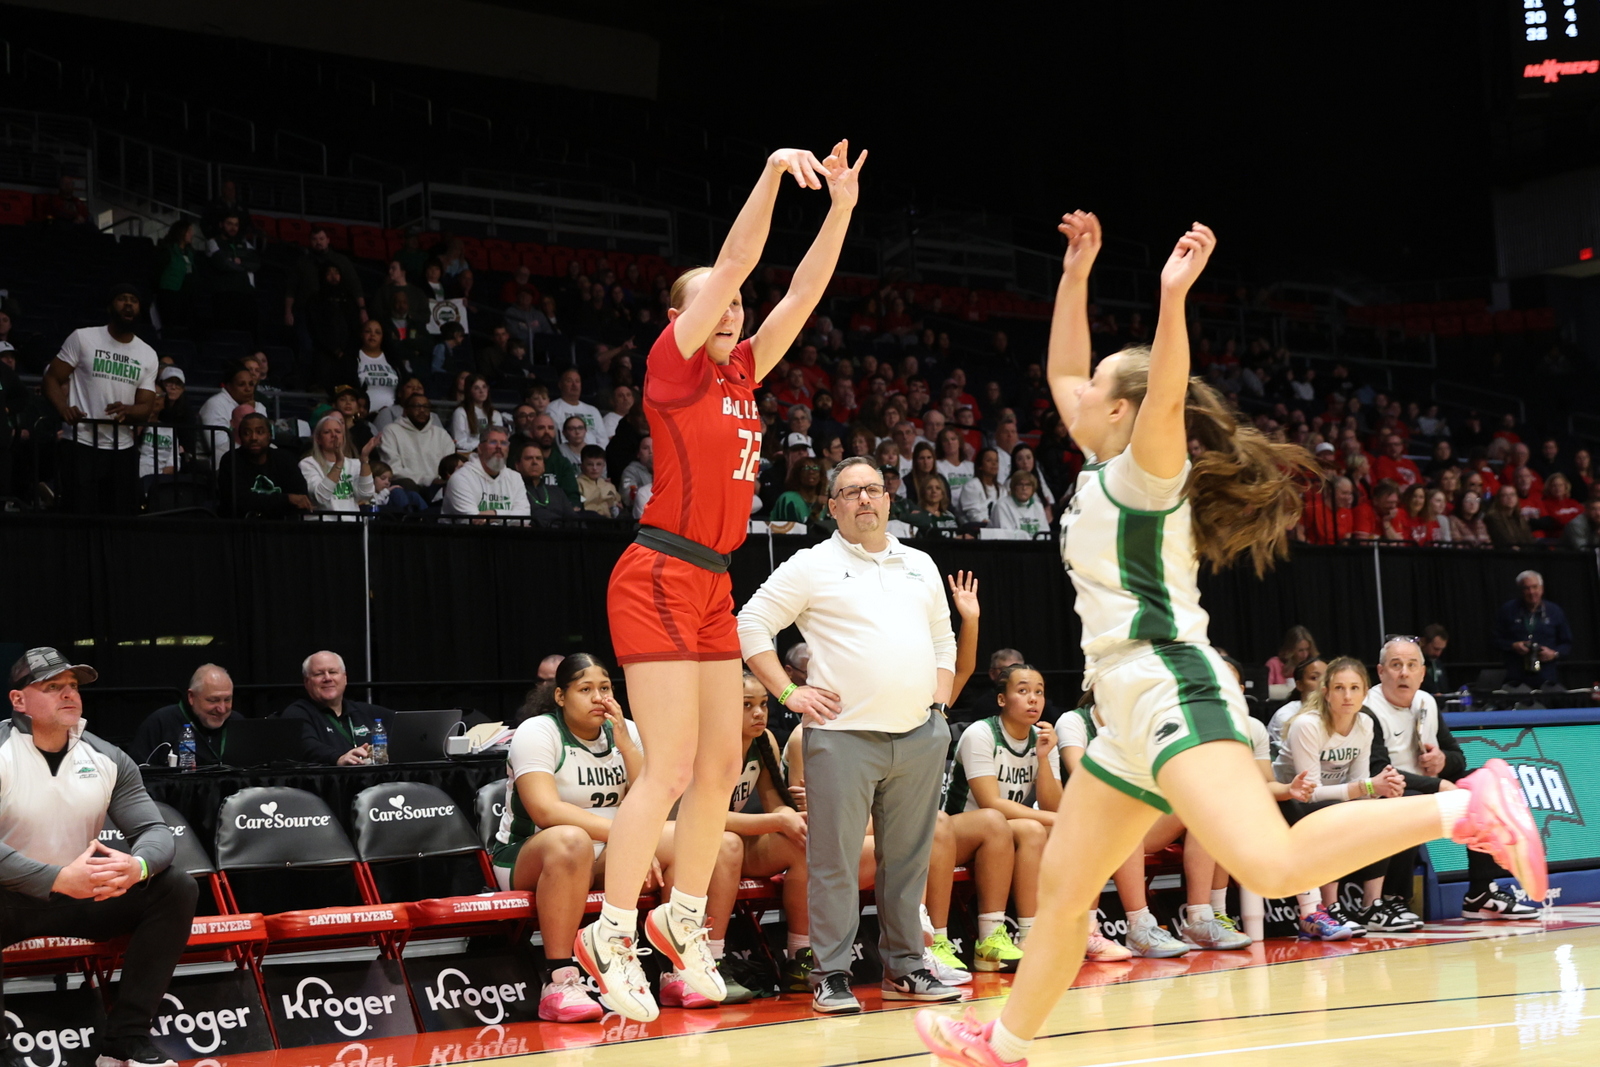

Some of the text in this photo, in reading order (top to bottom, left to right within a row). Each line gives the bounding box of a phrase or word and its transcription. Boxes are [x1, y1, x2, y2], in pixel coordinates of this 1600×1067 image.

[1525, 8, 1577, 25] 30 4
[1565, 23, 1578, 38] 4
[95, 349, 130, 364] IT'S OUR
[92, 358, 142, 382] MOMENT
[364, 376, 399, 388] ATORS
[732, 428, 762, 482] 32
[577, 764, 626, 787] LAUREL
[235, 813, 331, 830] CareSource
[369, 805, 454, 823] CareSource
[454, 898, 530, 913] DAYTON FLYERS
[308, 910, 394, 926] DAYTON FLYERS
[208, 920, 252, 934] FLYERS
[2, 938, 45, 953] AYTON
[425, 967, 527, 1026] Kroger
[281, 976, 397, 1038] Kroger
